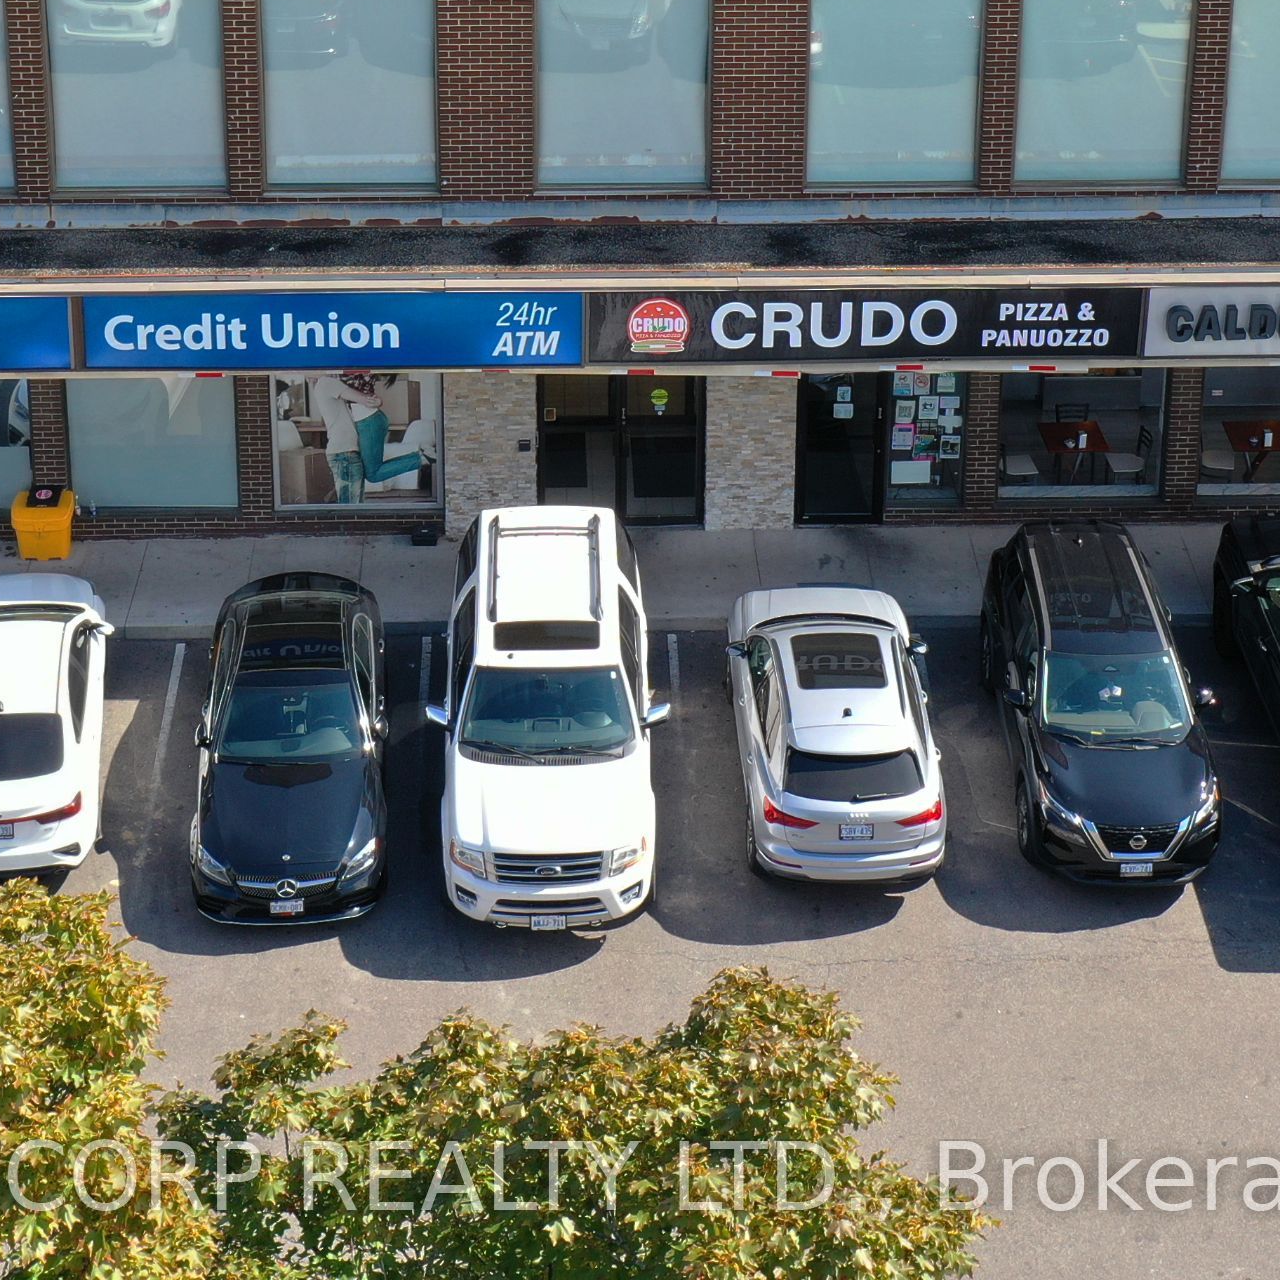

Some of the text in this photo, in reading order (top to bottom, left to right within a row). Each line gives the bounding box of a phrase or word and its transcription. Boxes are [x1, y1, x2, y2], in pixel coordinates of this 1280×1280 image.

[495, 302, 558, 326] 24hr
[999, 302, 1096, 322] PIZZA &
[104, 312, 400, 351] Credit Union
[632, 317, 684, 333] CRUDO
[711, 300, 959, 350] CRUDO
[491, 330, 560, 358] ATM
[981, 328, 1110, 348] PANUOZZO
